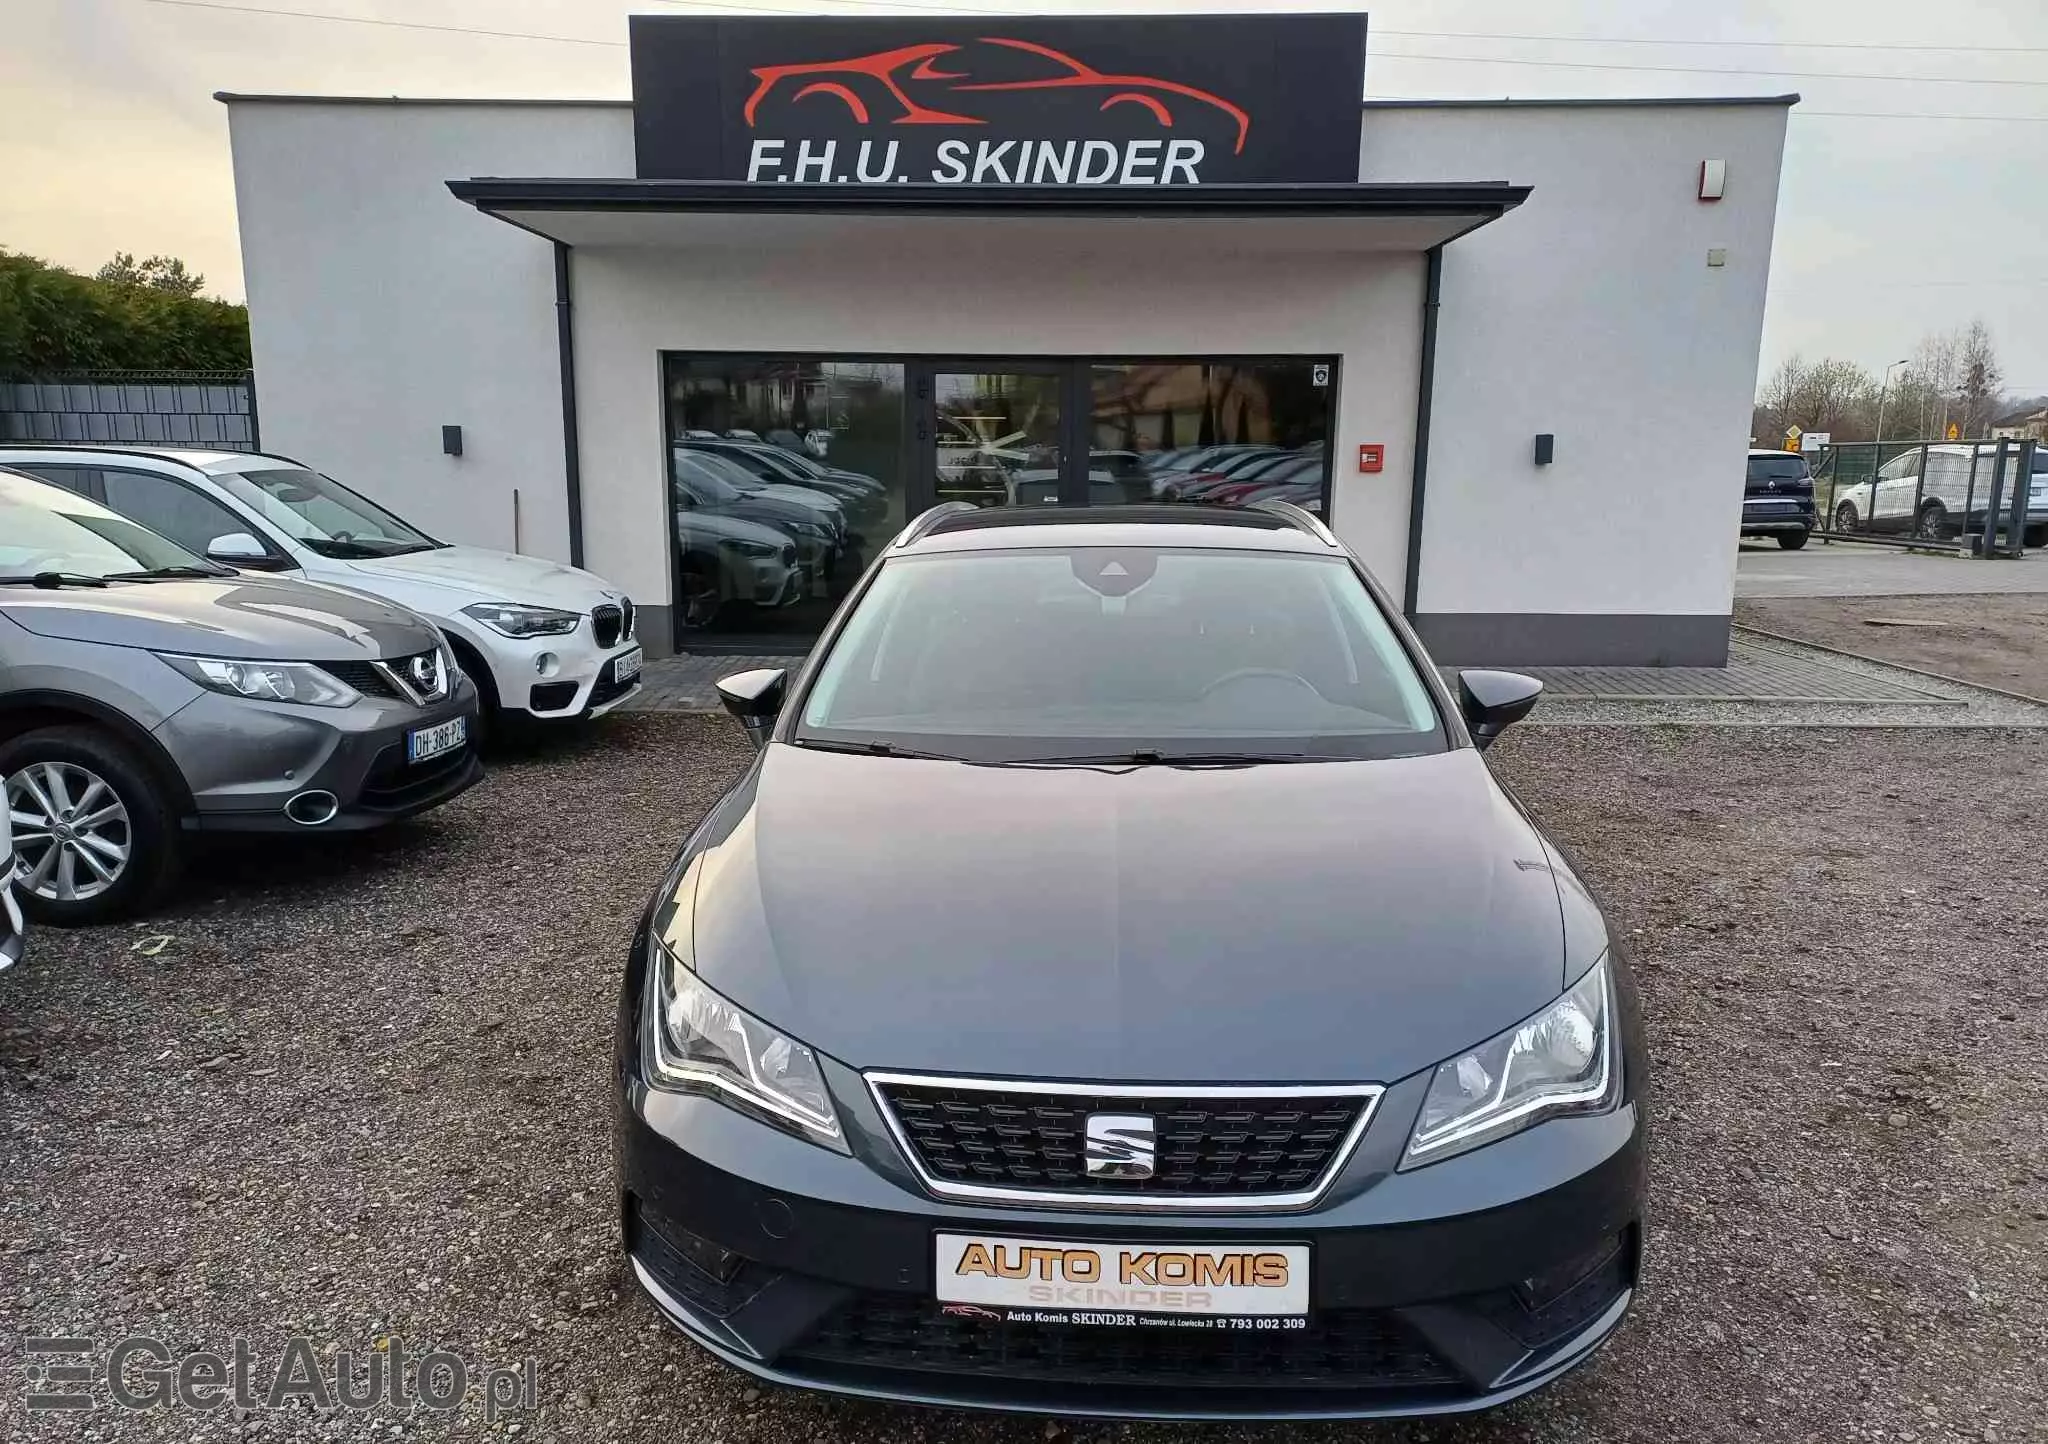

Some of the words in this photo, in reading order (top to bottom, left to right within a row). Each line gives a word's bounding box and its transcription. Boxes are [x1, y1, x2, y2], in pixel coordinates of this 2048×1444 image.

[747, 139, 909, 183] F.H.U.
[931, 139, 1205, 184] SKINDER
[955, 1243, 1101, 1283] AUTO
[1119, 1251, 1289, 1287] KOMIS
[1029, 1285, 1212, 1308] SKINDER
[1006, 1311, 1032, 1322] Auto
[1034, 1312, 1069, 1323] Komis
[1071, 1313, 1137, 1326] SKINDER
[1230, 1318, 1252, 1329] 793
[1256, 1318, 1279, 1329] 002
[1283, 1318, 1306, 1329] 309
